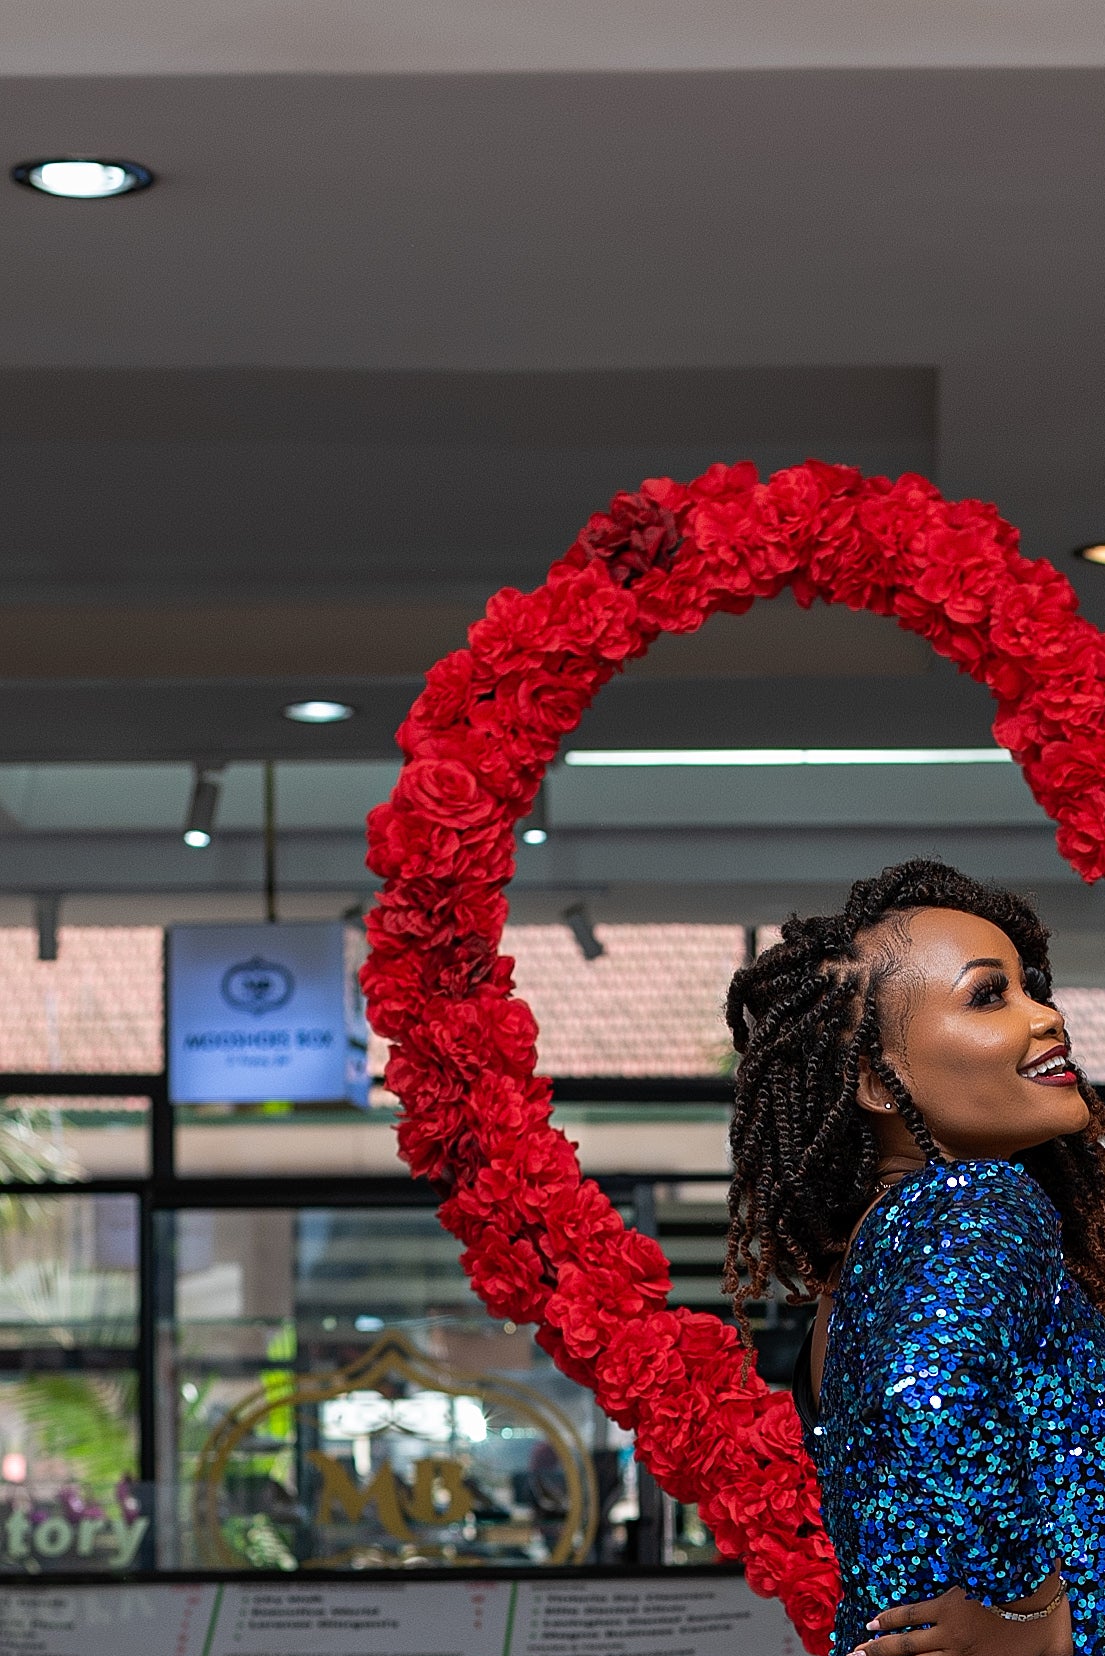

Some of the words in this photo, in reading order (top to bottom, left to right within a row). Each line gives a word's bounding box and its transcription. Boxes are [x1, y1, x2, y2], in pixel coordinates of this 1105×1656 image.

[296, 1029, 333, 1048] BOX
[307, 1450, 474, 1541] MB
[5, 1511, 149, 1568] tory
